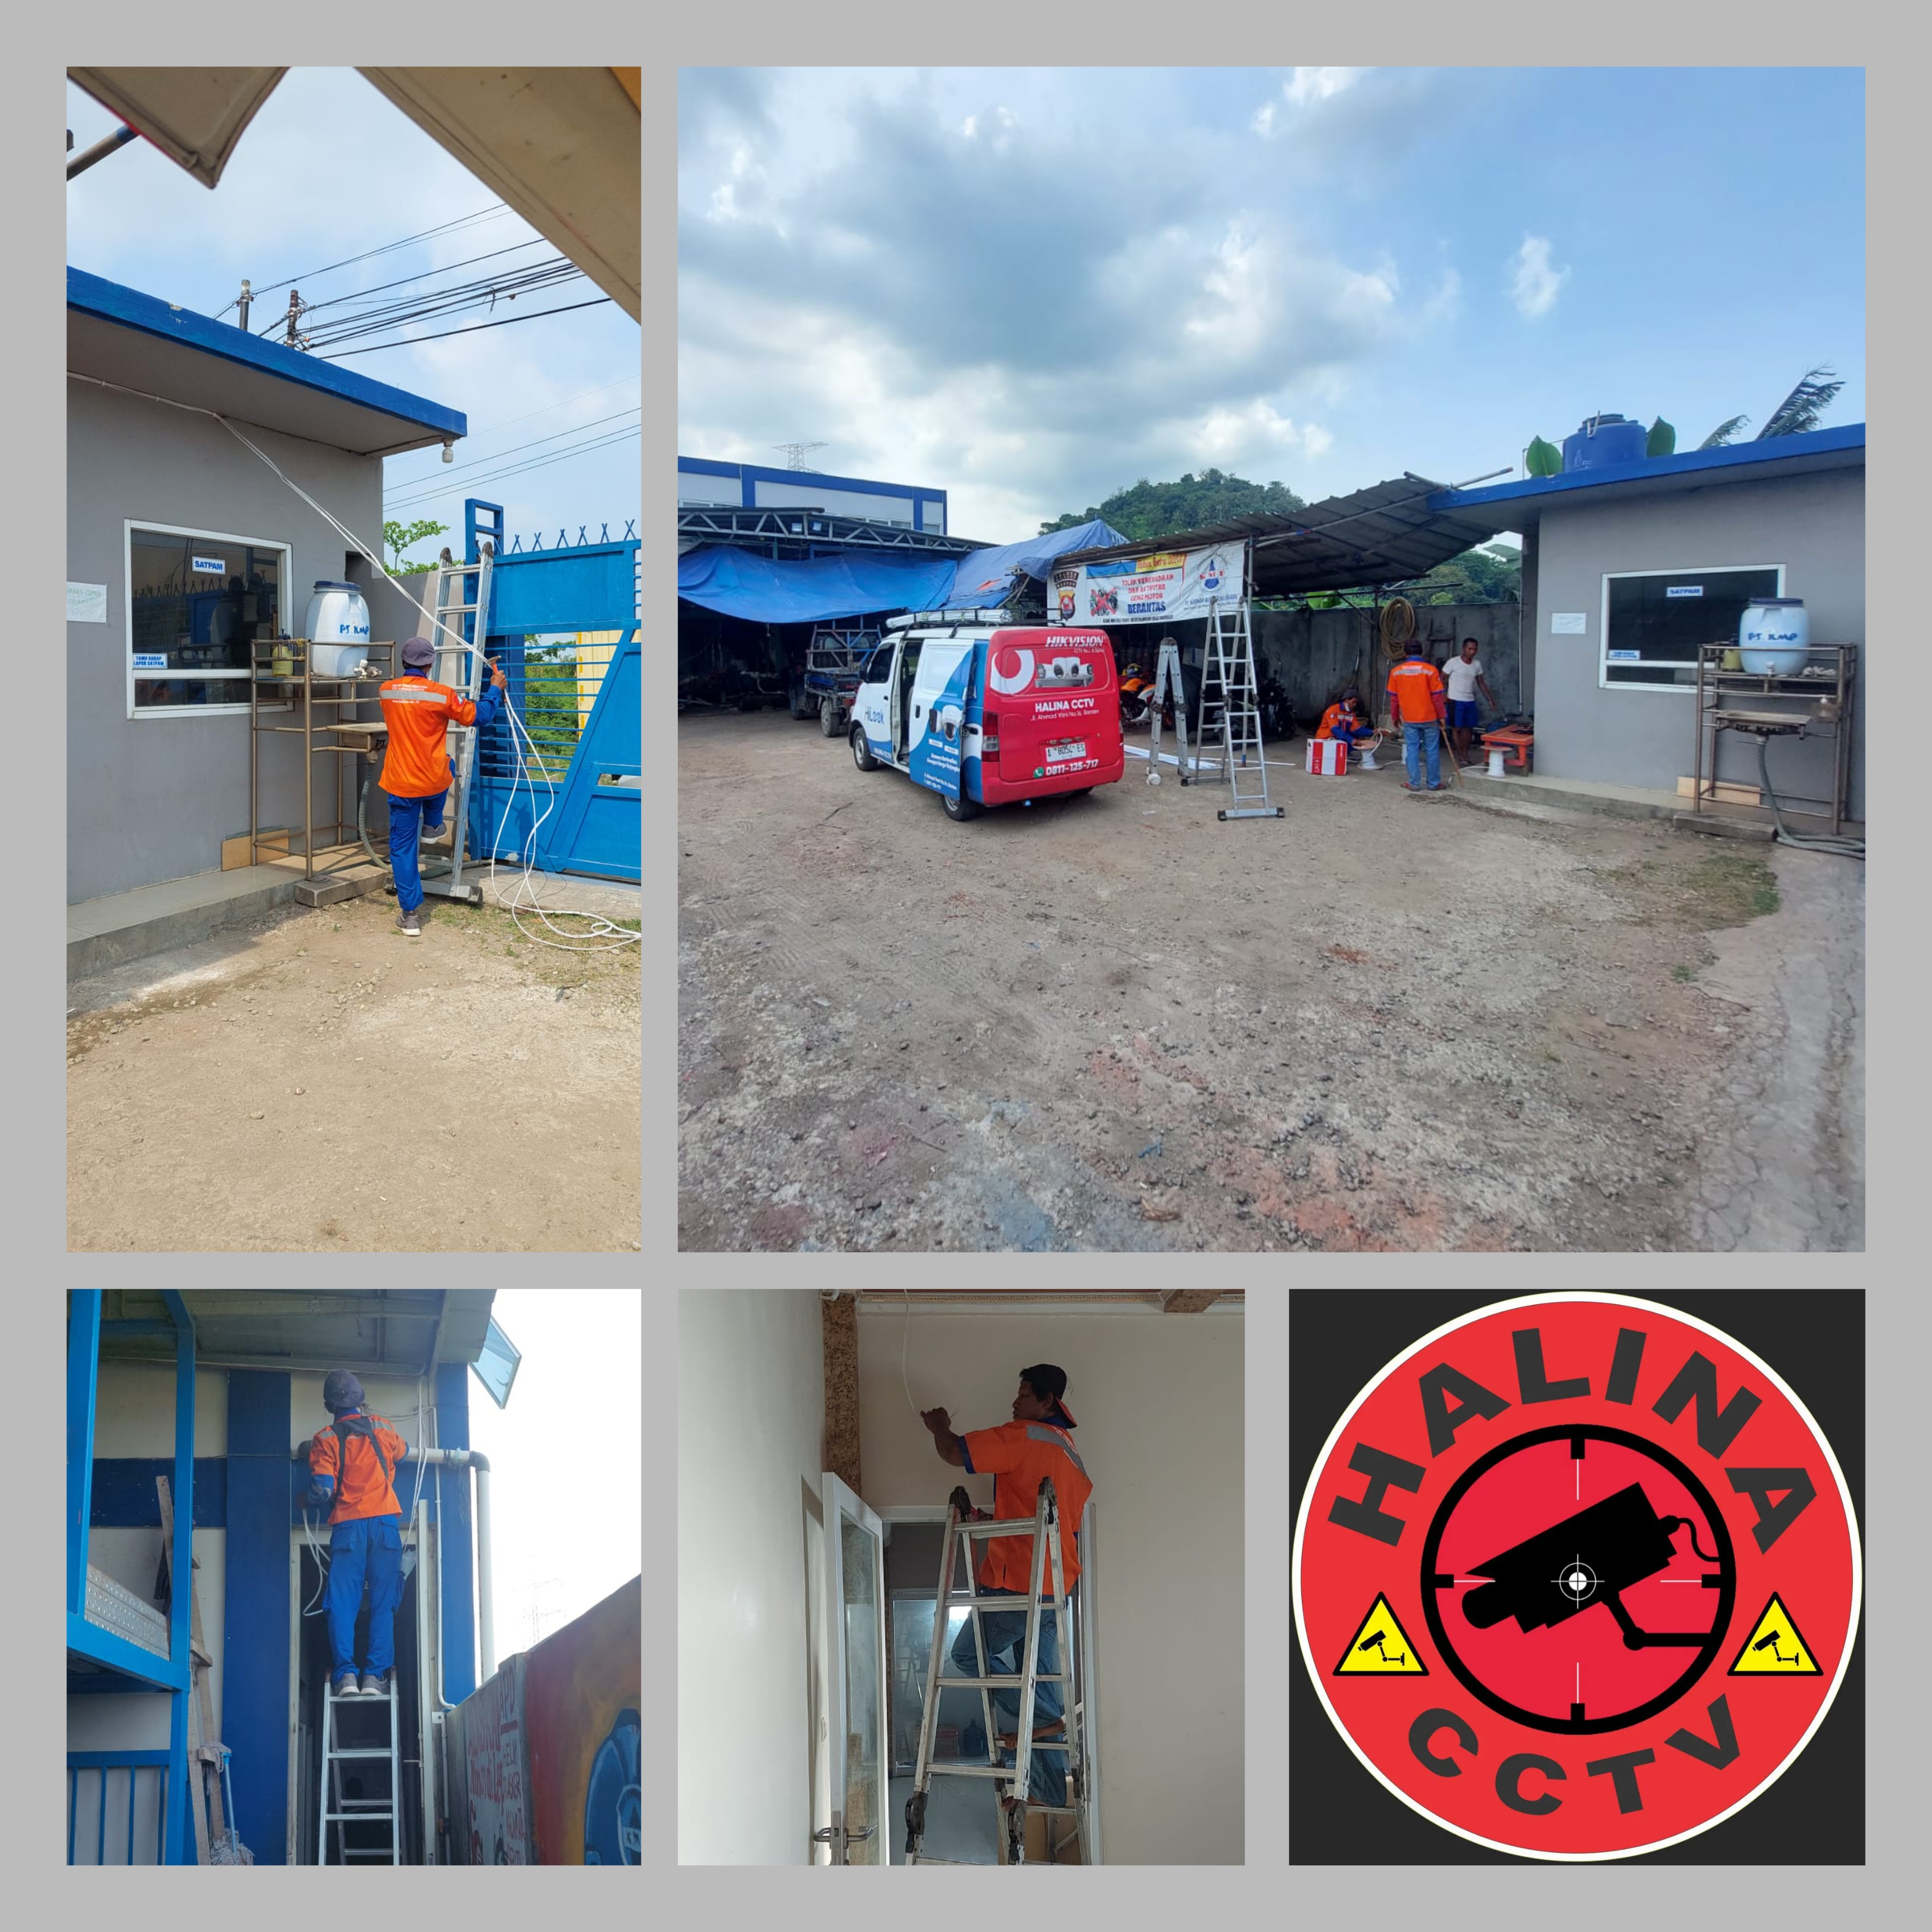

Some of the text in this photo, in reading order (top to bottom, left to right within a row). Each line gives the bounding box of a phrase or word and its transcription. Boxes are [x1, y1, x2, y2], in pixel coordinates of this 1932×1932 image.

[195, 560, 223, 571] SATPAM
[1127, 601, 1166, 614] BERANTAS
[340, 624, 369, 635] PT KMP
[1045, 635, 1104, 648] HIKVISION
[1748, 633, 1798, 641] PT KMP
[1034, 698, 1095, 713] HALINA CCTV
[375, 739, 386, 748] PT
[1077, 743, 1084, 752] ES
[1046, 759, 1099, 776] 0811-125-717
[1327, 1327, 1817, 1555] HALINA
[499, 1665, 516, 1720] APD
[1408, 1692, 1740, 1816] CCTV
